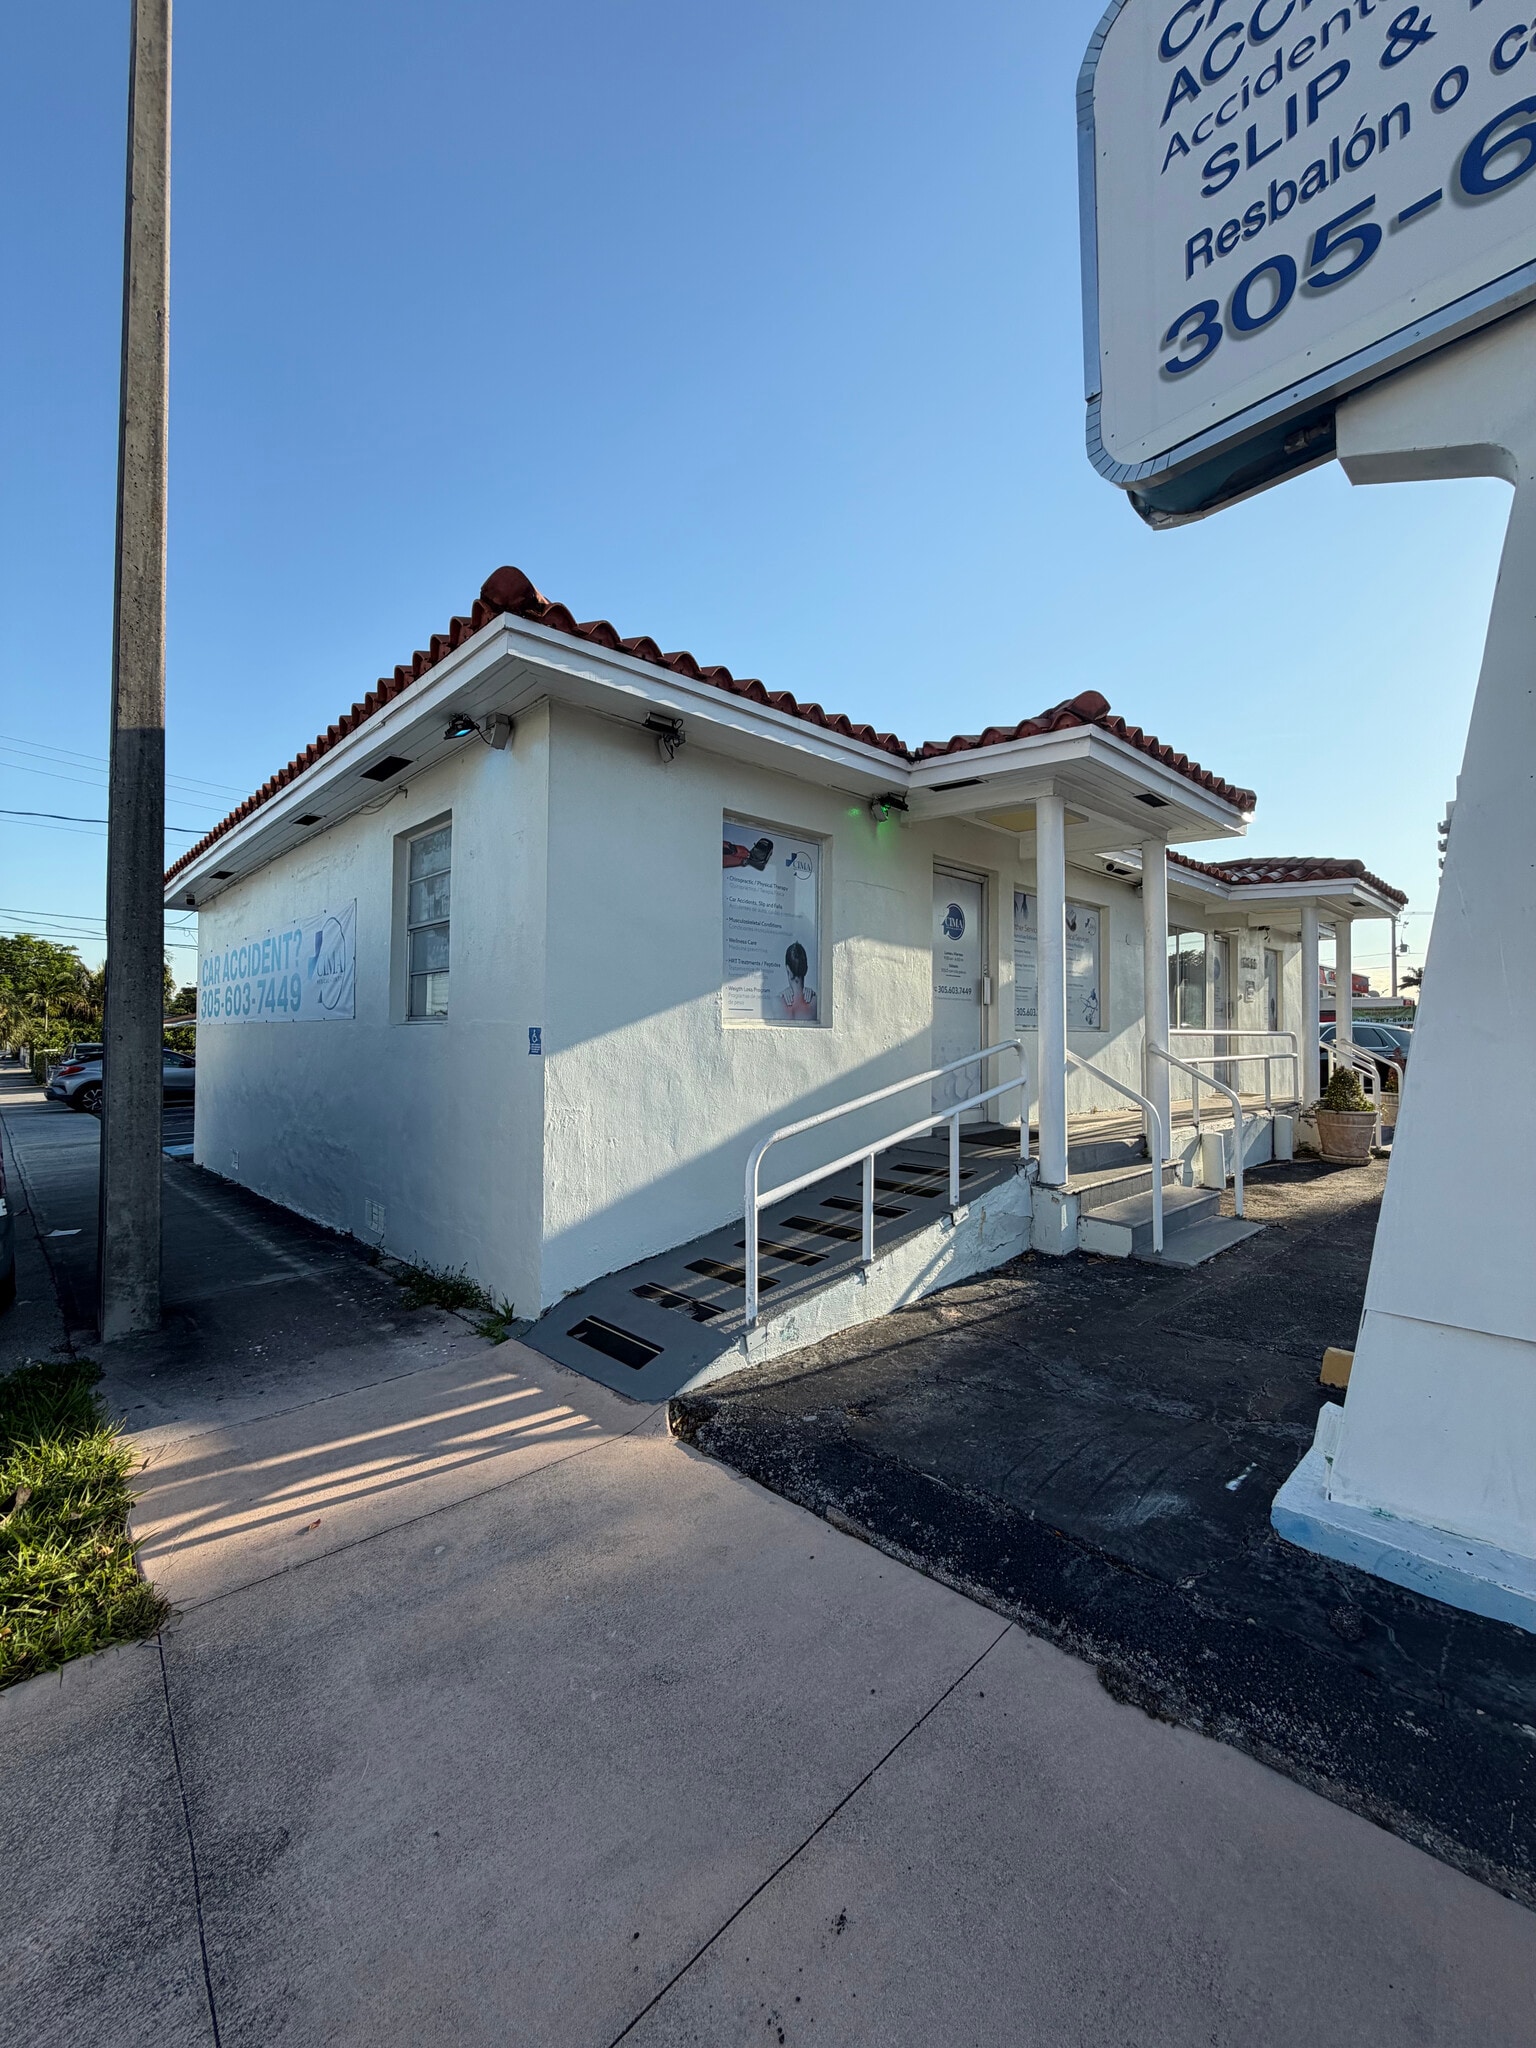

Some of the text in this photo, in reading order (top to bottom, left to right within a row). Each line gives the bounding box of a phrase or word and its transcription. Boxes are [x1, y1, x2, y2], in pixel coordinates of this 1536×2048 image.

[1161, 0, 1311, 128] ACC
[1201, 6, 1437, 198] SLIP &
[1187, 102, 1411, 280] Resbalón
[1433, 65, 1469, 110] o
[201, 973, 302, 1018] 305-603-7449
[203, 929, 302, 987] CAR ACCIDENT?
[938, 985, 972, 996] 305.603.7449
